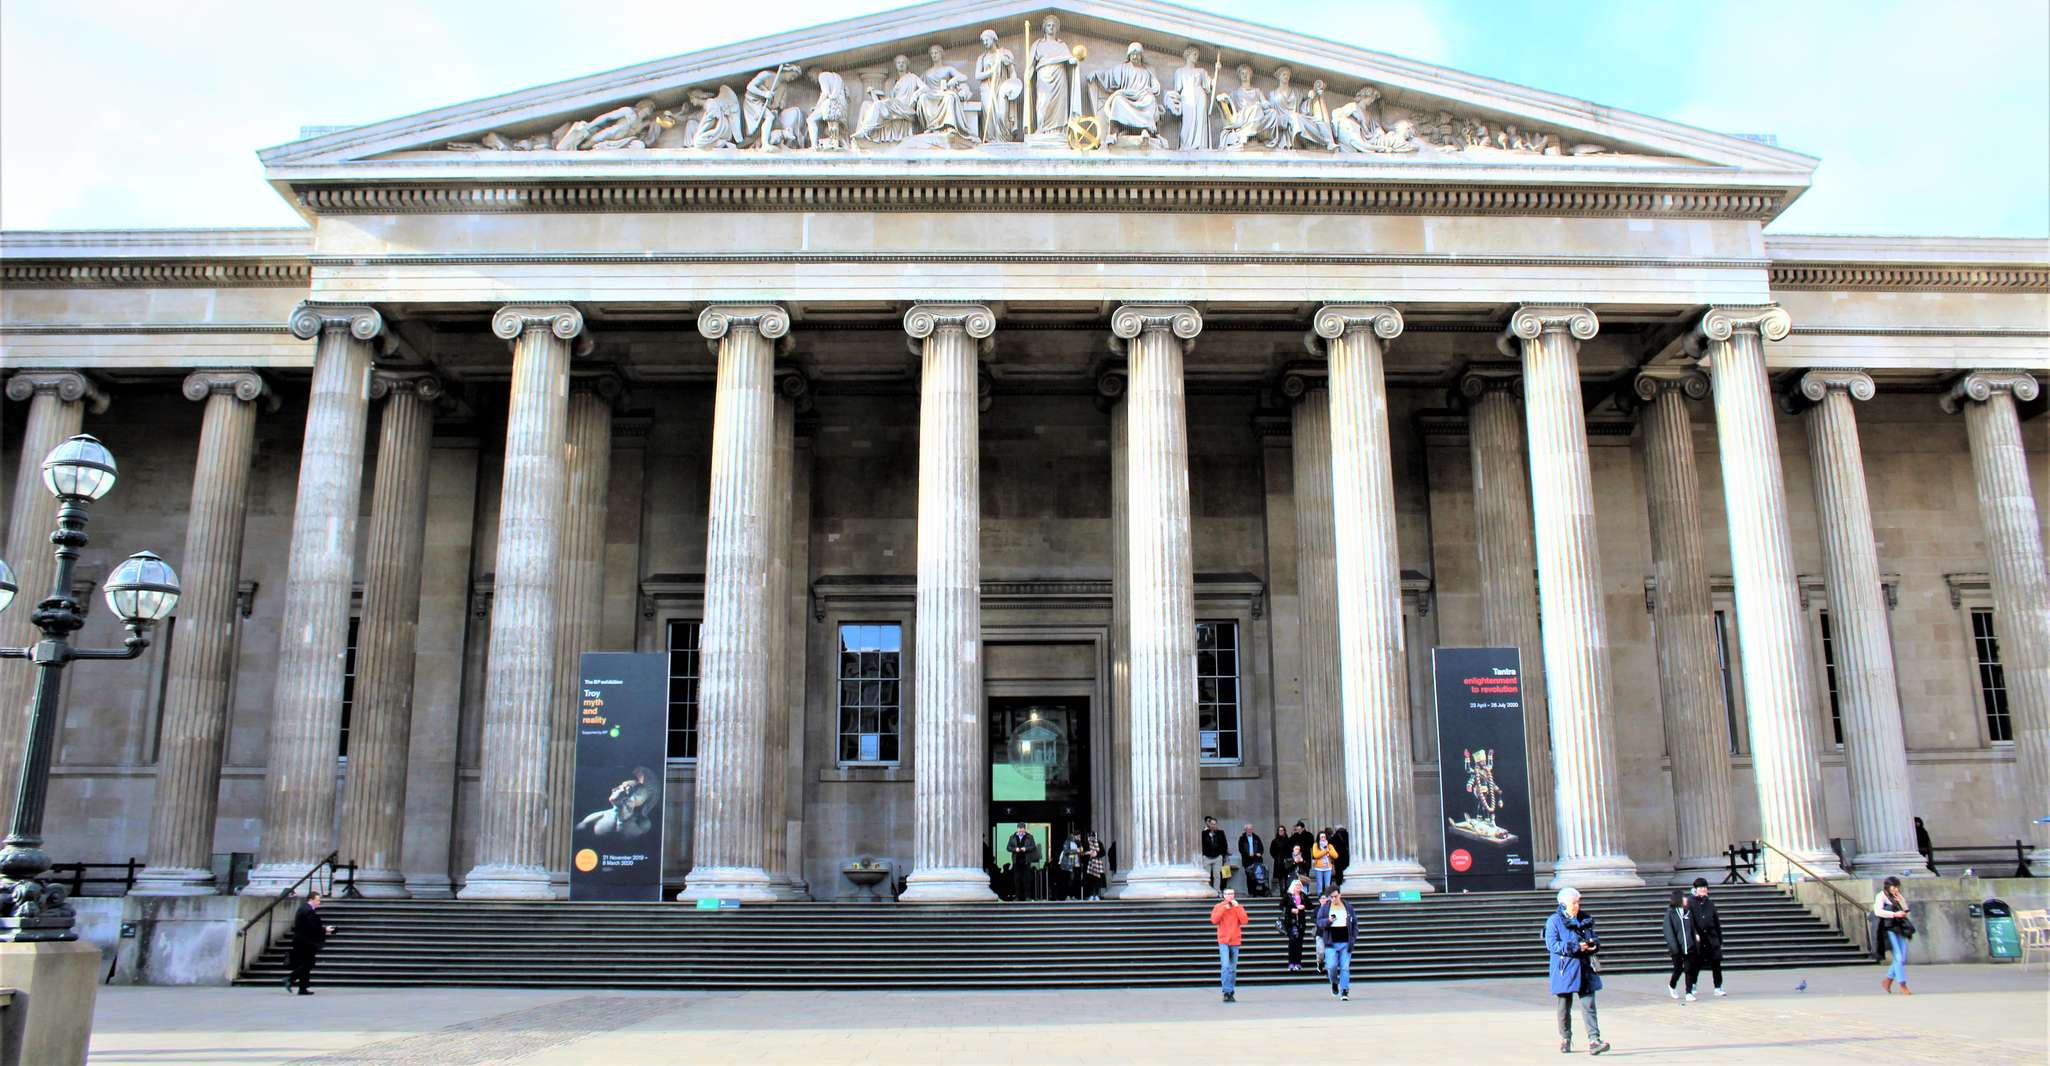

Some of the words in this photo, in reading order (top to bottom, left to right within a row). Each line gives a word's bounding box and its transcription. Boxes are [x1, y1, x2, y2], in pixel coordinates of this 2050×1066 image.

[1464, 677, 1517, 686] enlightenment
[584, 689, 600, 698] Troy
[583, 699, 603, 707] myth
[583, 707, 598, 715] and
[582, 716, 606, 726] reality
